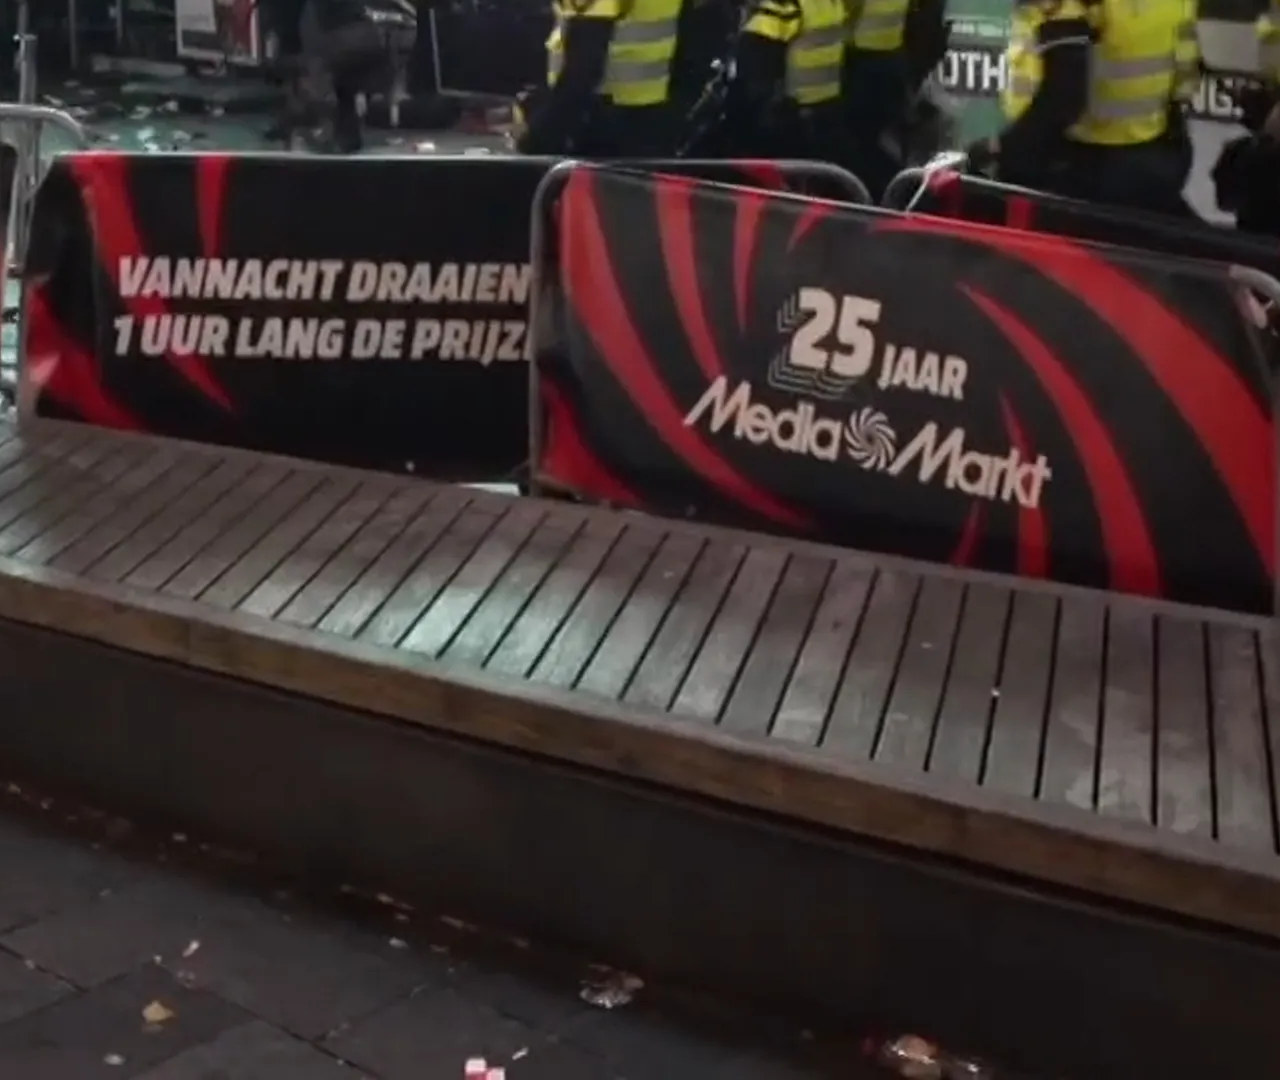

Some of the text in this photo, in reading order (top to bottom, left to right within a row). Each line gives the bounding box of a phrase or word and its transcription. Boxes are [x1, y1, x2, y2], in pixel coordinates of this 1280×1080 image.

[119, 255, 533, 304] VANNACHT DRAAIEN
[114, 312, 532, 367] 1 UUR LANG DE PRIJZ
[790, 286, 969, 401] 25 JAAR
